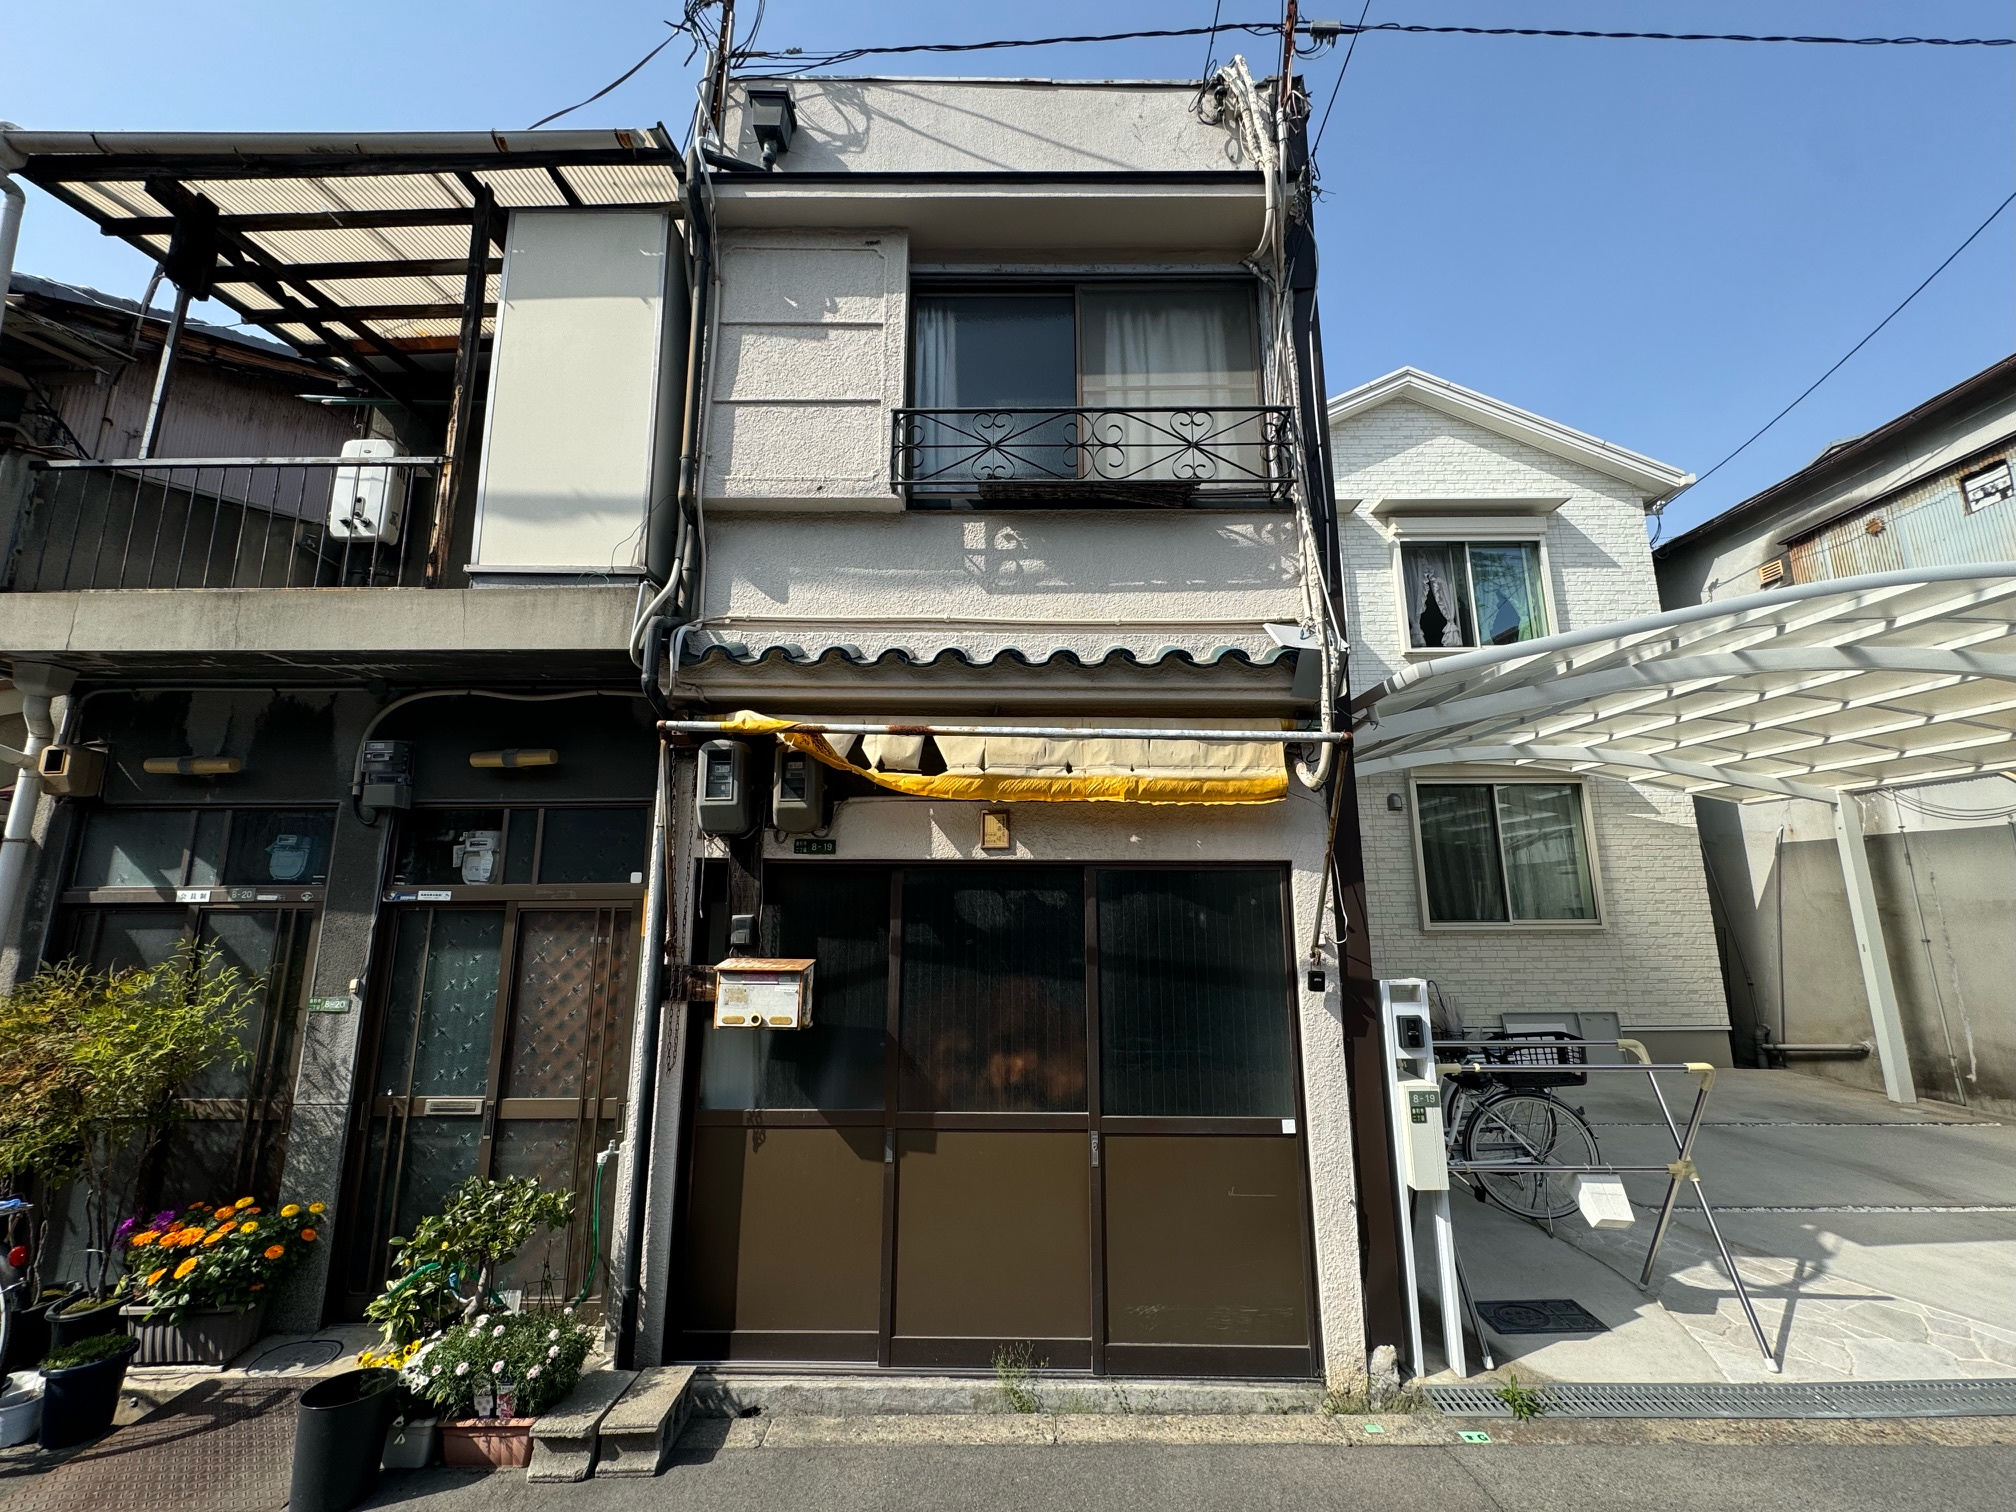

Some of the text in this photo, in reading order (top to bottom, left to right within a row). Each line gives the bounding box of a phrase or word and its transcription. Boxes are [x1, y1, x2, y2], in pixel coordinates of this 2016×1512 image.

[811, 843, 833, 851] 8-19
[231, 890, 253, 899] 8-20
[324, 1000, 346, 1009] 8-20
[1412, 1094, 1436, 1103] 8-19
